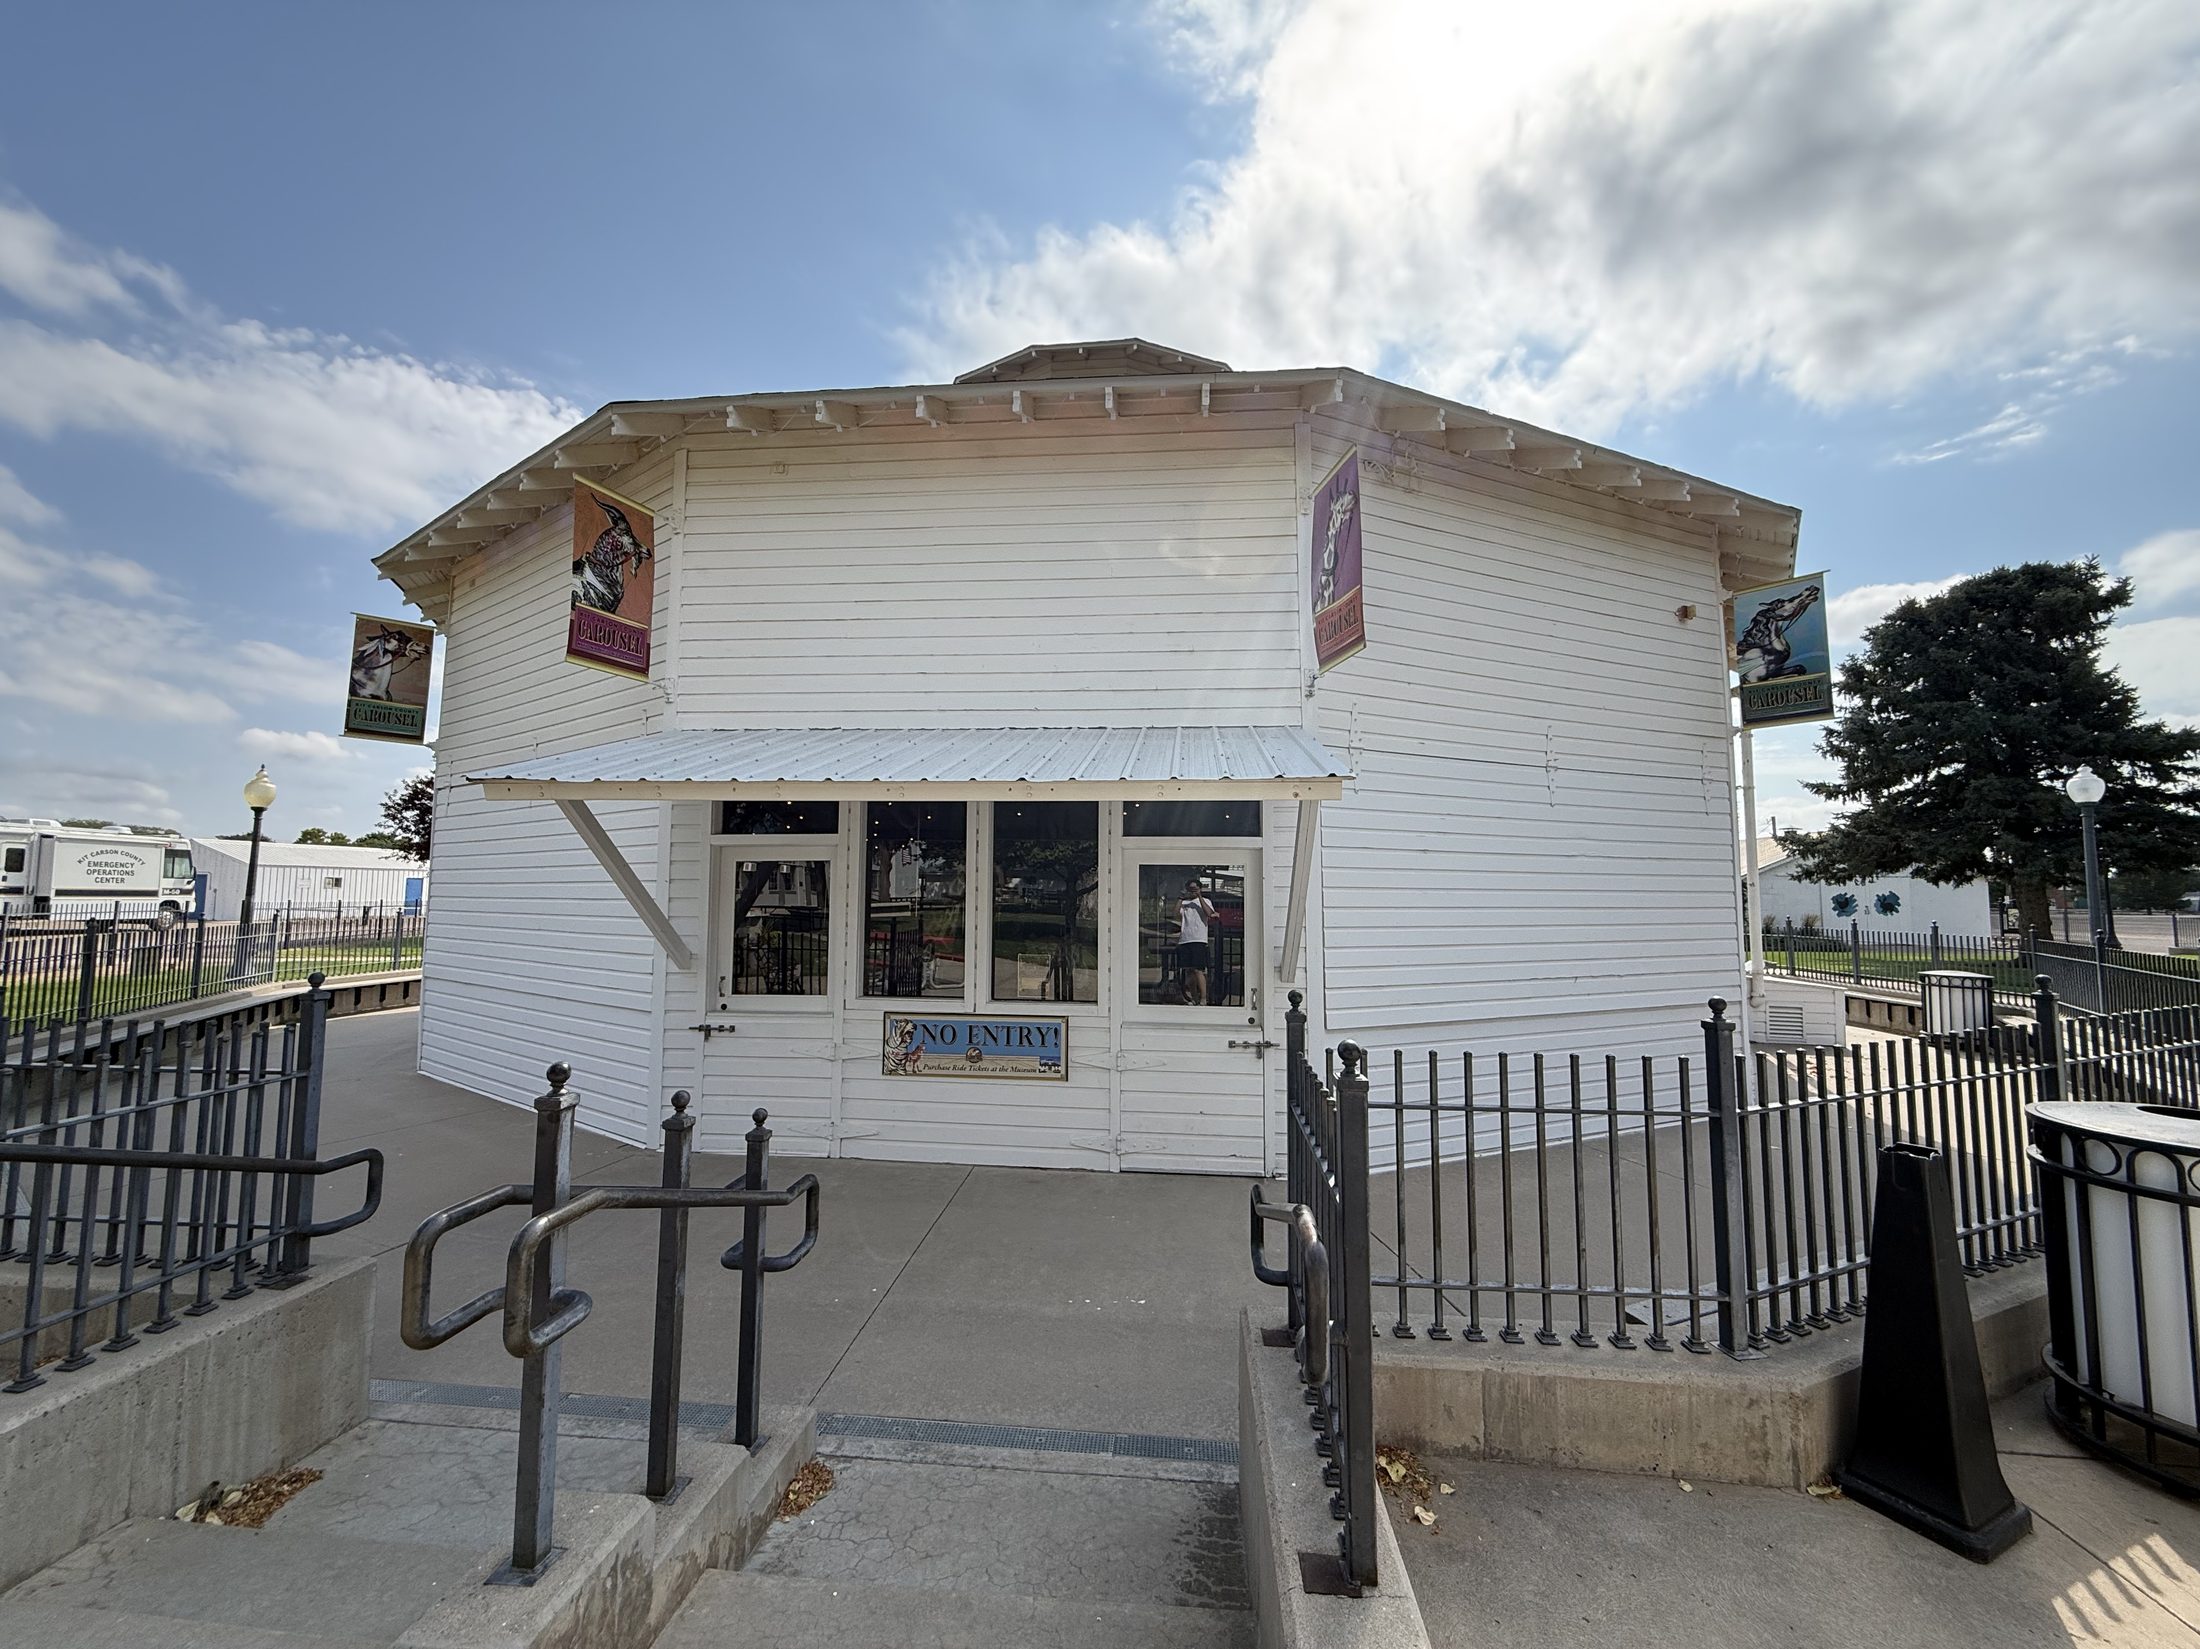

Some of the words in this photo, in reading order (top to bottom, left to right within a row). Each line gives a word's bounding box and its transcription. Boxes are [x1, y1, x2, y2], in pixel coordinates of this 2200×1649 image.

[1318, 605, 1359, 647] CAROUSEL
[578, 620, 644, 657] CAROUSEL
[1748, 685, 1824, 710] CAROUSEL
[353, 707, 418, 727] CAROUSEL
[77, 854, 89, 865] KIT
[90, 849, 119, 858] CARSON
[120, 850, 146, 866] COUNTY
[87, 860, 135, 869] EMERGENCY
[86, 868, 135, 877] OPERATIONS
[94, 876, 126, 884] CENTER
[921, 1023, 957, 1046] NO
[966, 1024, 1060, 1048] ENTRY!
[922, 1063, 951, 1072] Purchase
[952, 1064, 967, 1072] Ride
[968, 1064, 989, 1072] Tickets
[998, 1065, 1008, 1073] the
[1009, 1065, 1037, 1073] Museum
